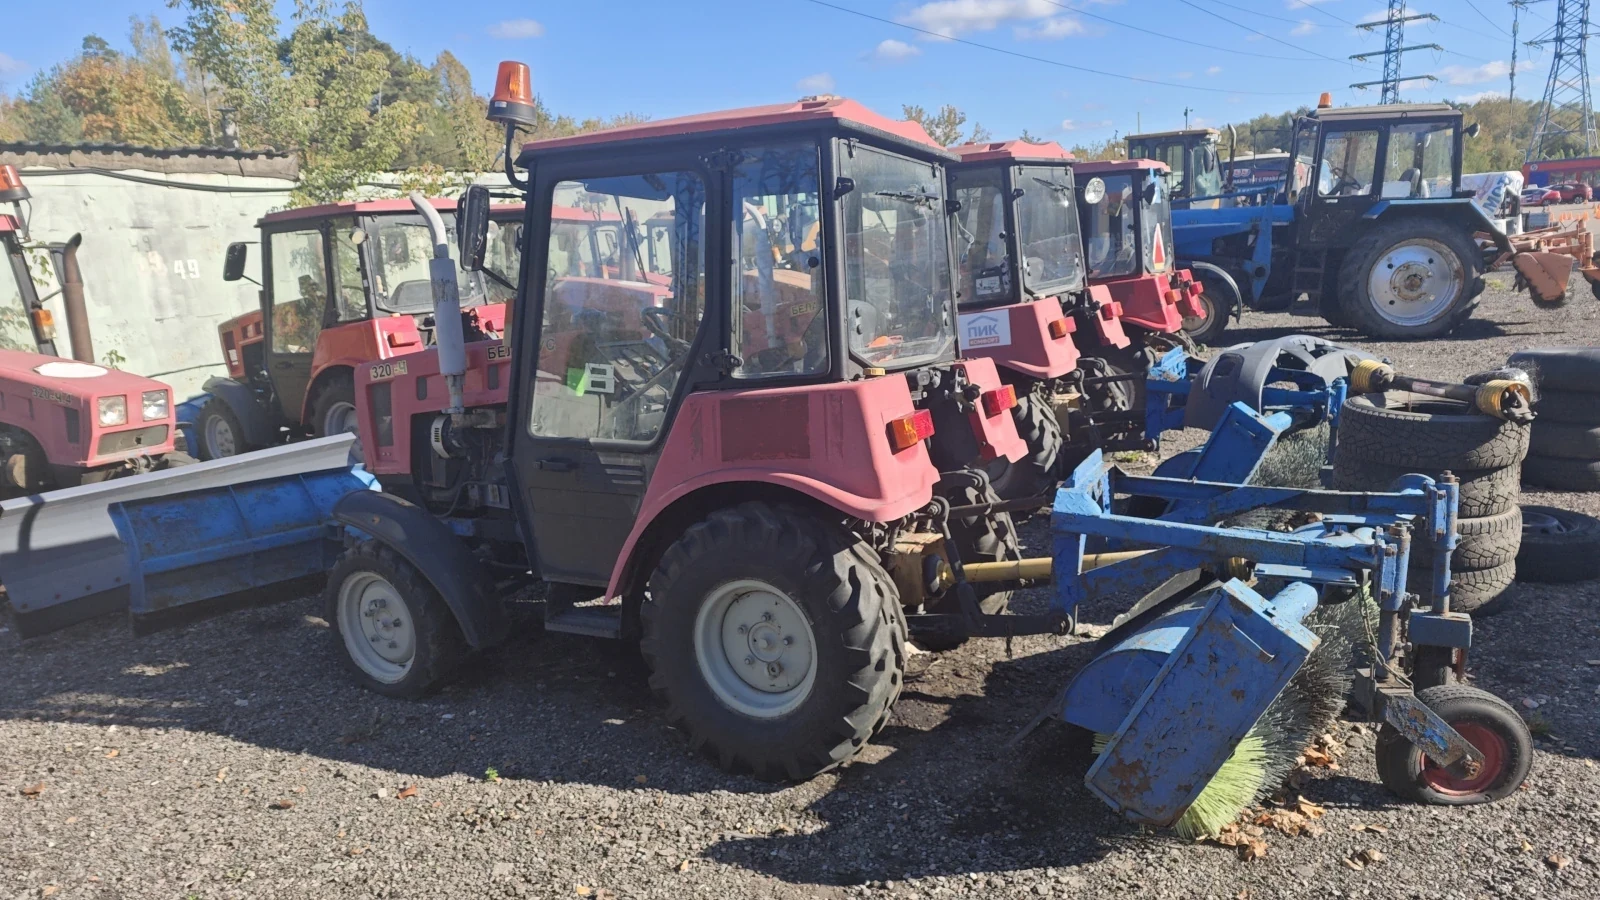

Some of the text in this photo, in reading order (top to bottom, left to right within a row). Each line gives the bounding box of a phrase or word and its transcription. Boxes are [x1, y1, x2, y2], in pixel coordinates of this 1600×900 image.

[174, 259, 200, 279] 49
[968, 324, 998, 337] ПИК
[970, 337, 999, 346] КОМФОРТ
